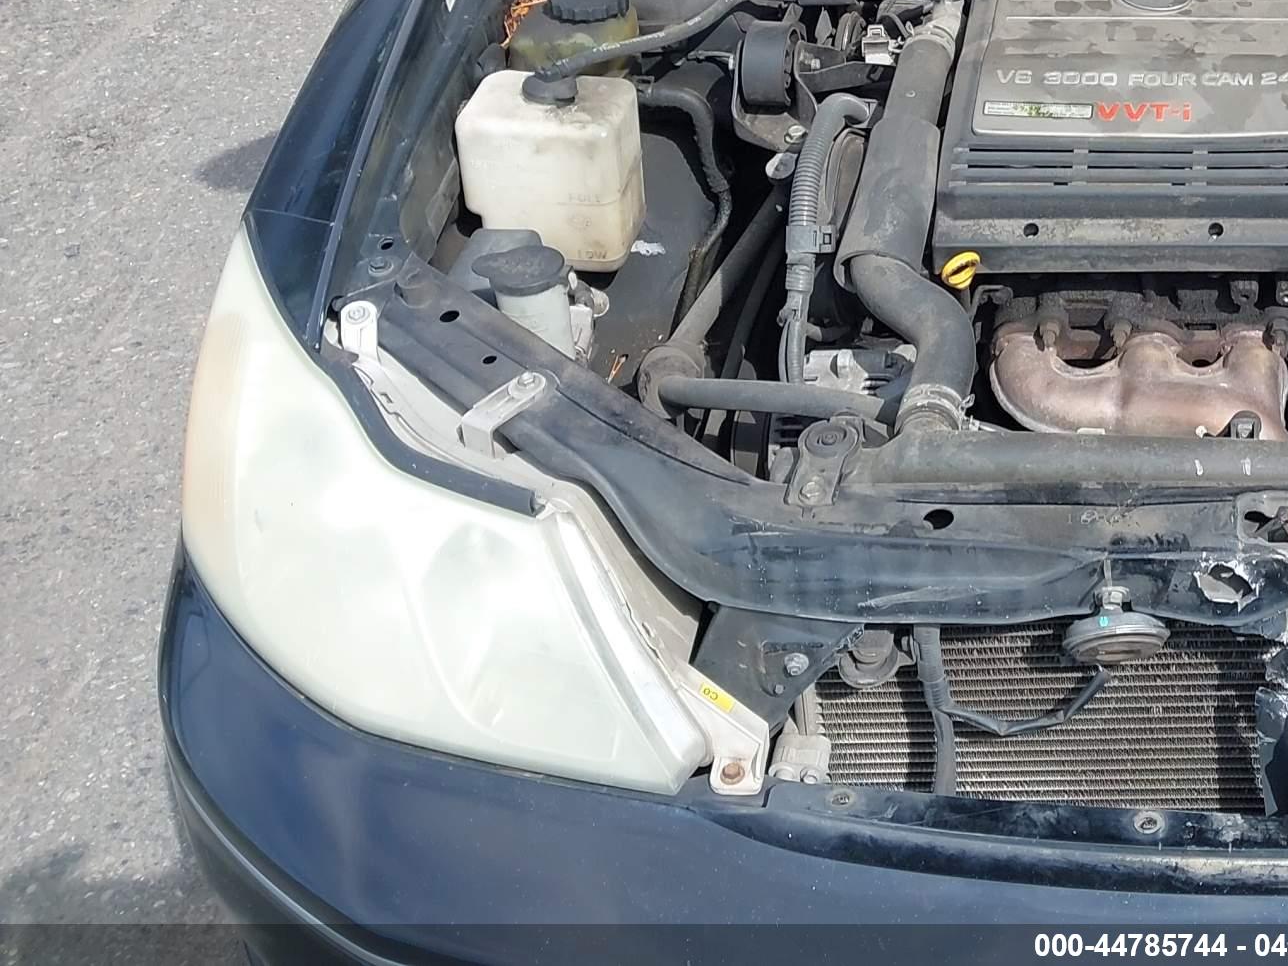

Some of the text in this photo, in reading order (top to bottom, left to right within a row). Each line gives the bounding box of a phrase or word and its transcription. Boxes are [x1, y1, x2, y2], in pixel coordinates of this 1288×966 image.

[996, 69, 1032, 84] V6
[1044, 71, 1118, 86] 3000
[1128, 72, 1197, 87] FOUR
[1202, 72, 1253, 87] CAM
[1097, 102, 1192, 122] VVT-i
